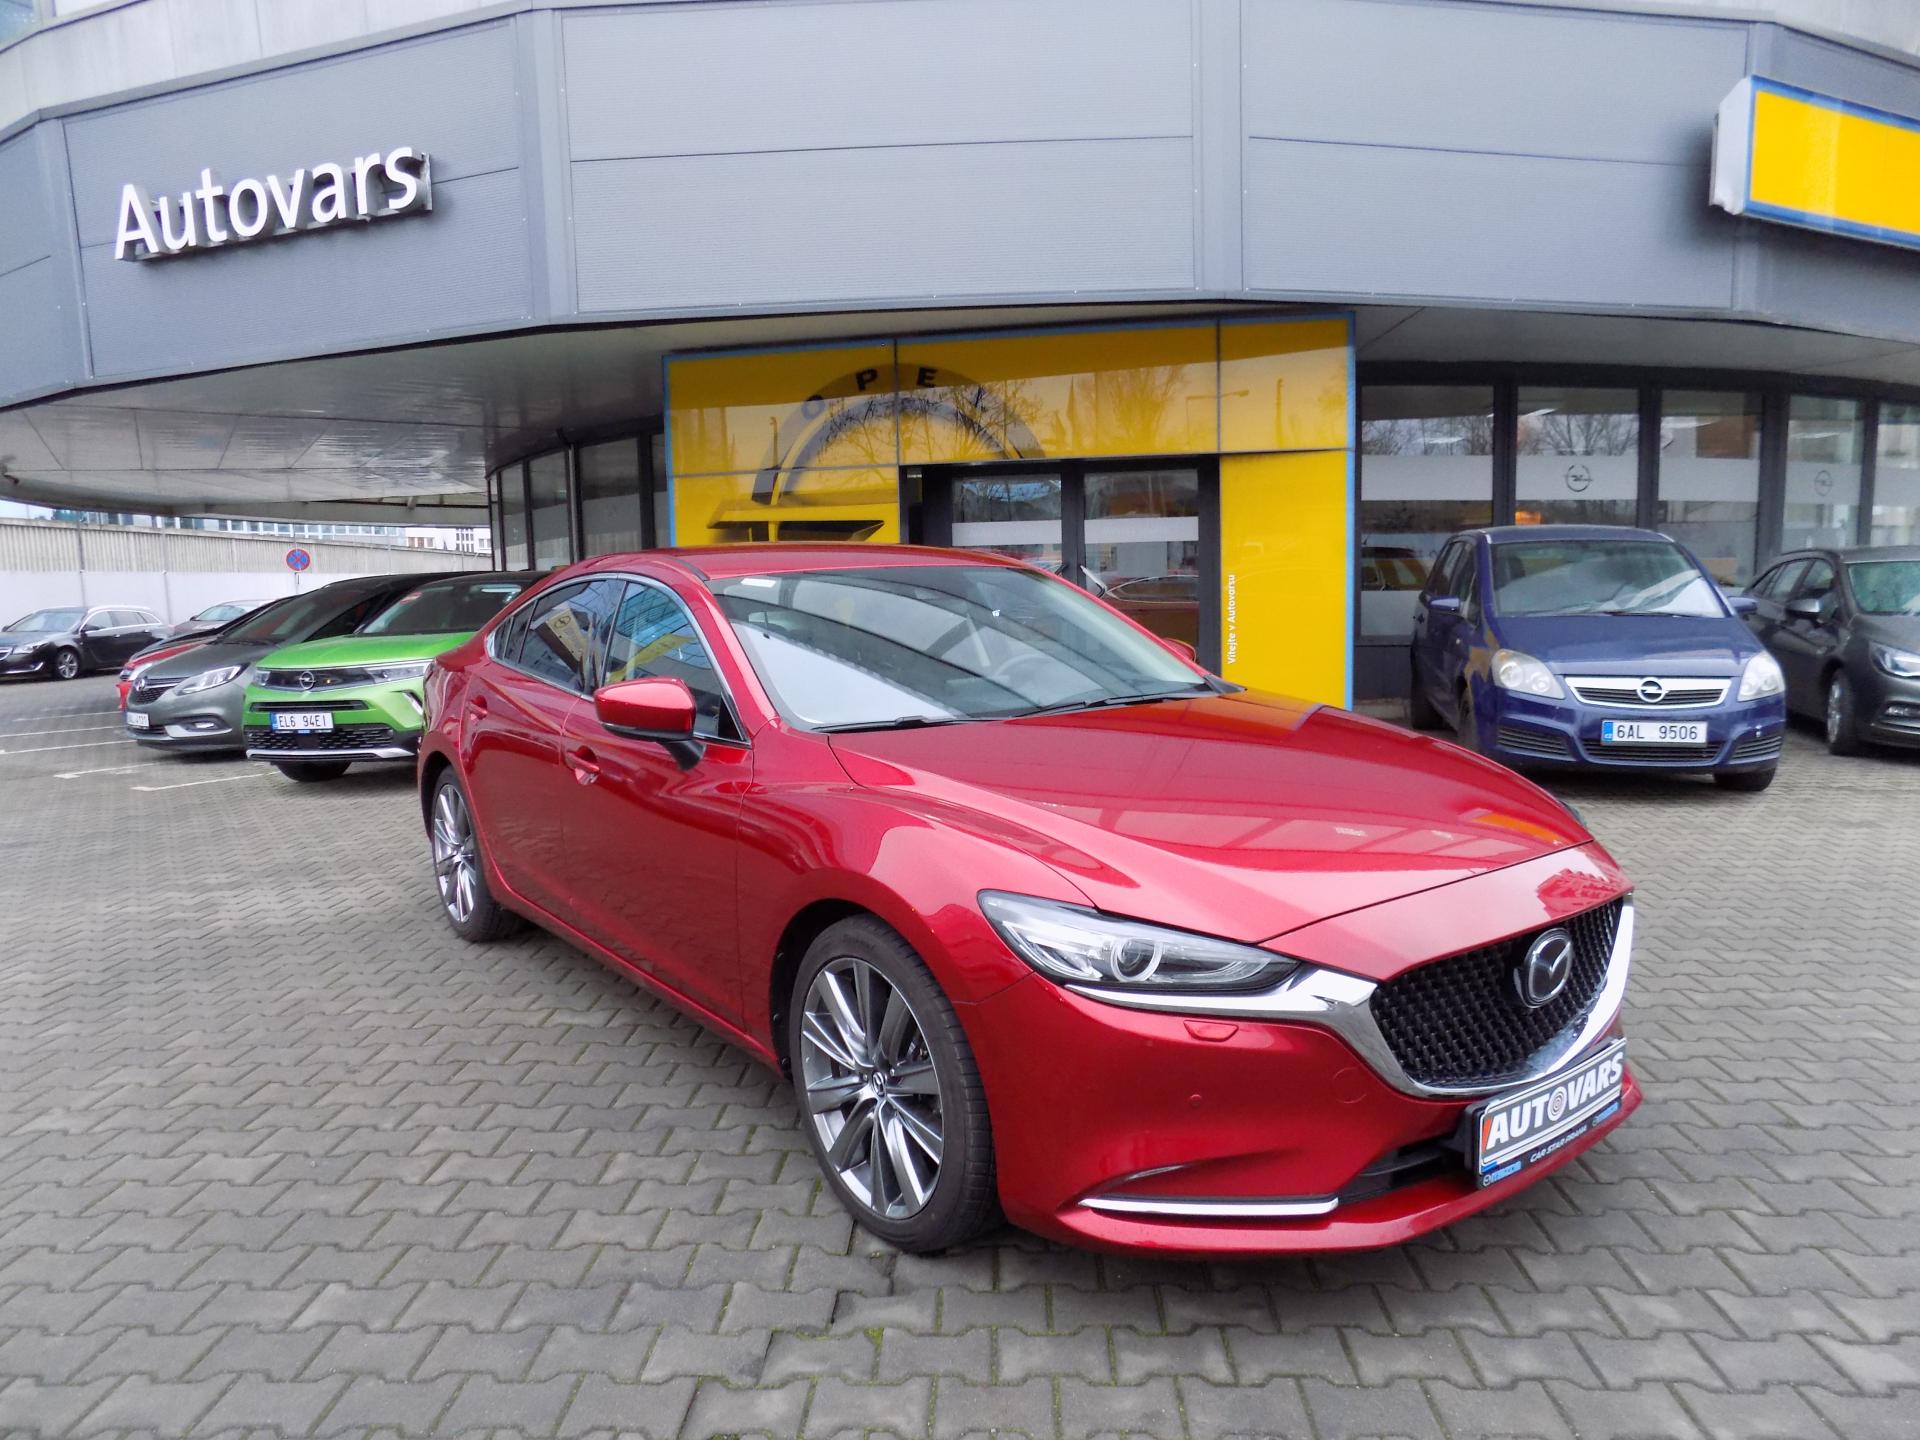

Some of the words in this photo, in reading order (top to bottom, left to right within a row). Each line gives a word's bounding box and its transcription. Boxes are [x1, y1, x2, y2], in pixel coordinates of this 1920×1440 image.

[113, 145, 420, 261] Autovars
[278, 715, 296, 728] EL6
[1616, 724, 1646, 739] 6AL
[1658, 725, 1698, 740] 9506
[1485, 1051, 1624, 1150] AUTOVARS
